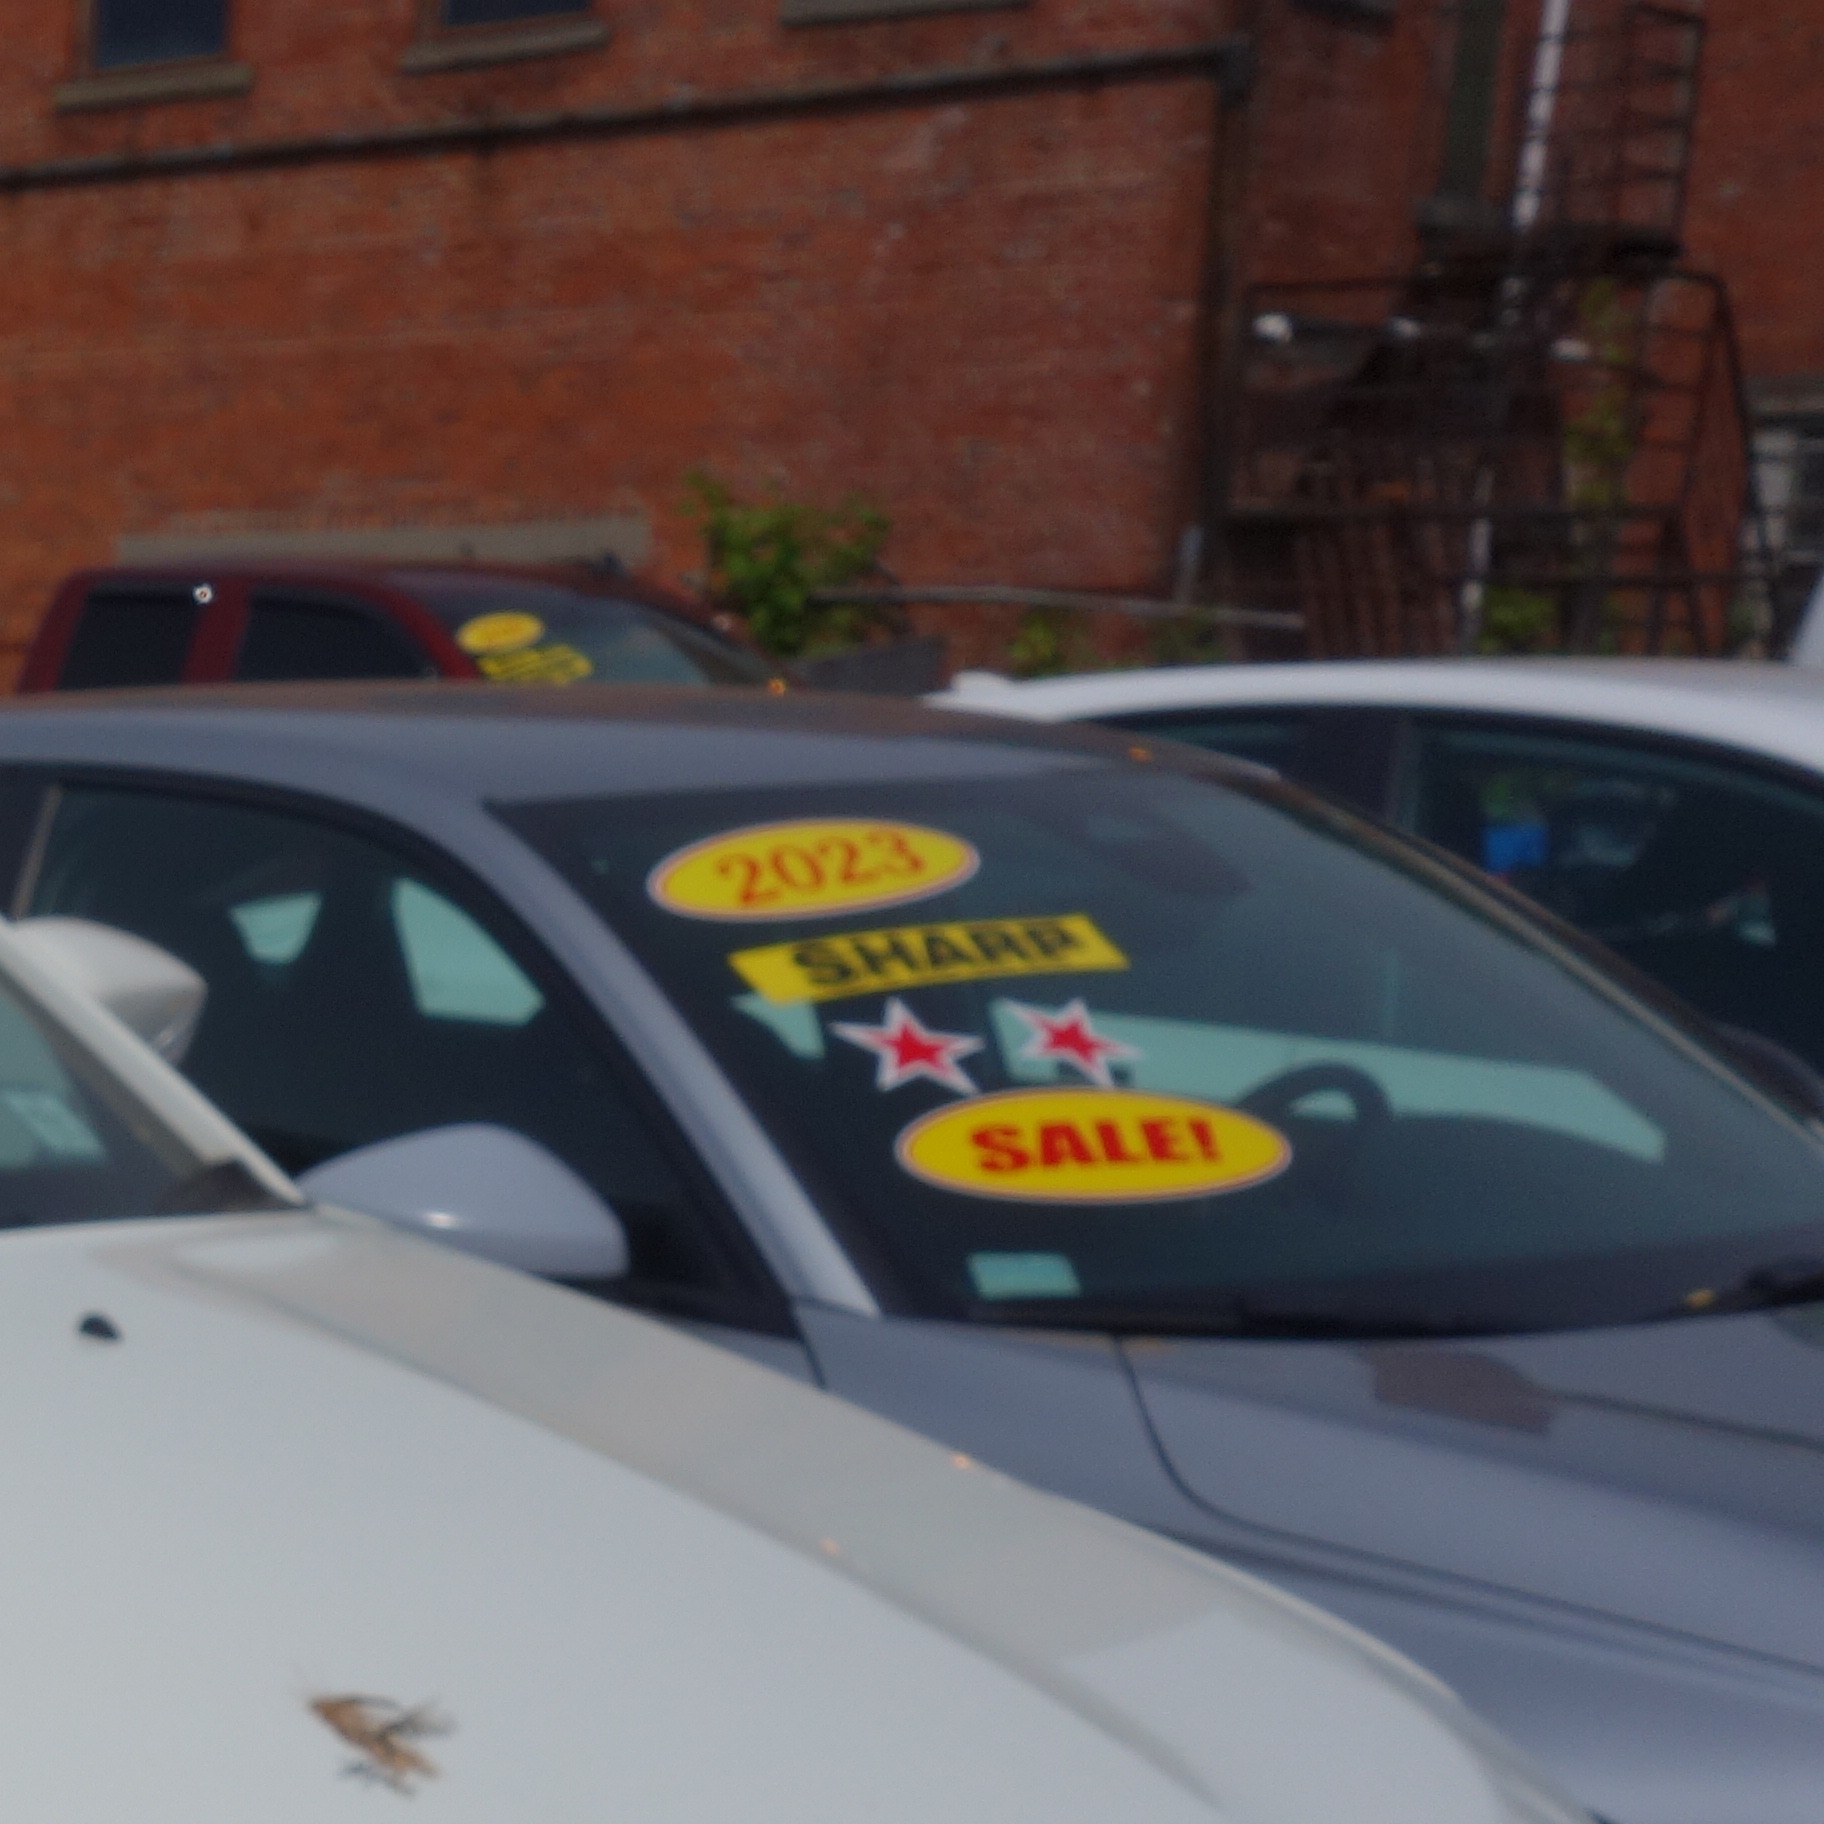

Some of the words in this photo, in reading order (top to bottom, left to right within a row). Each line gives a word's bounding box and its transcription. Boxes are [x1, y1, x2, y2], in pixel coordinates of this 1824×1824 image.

[718, 829, 925, 907] 2023
[793, 921, 1089, 986] SHARP
[970, 1118, 1220, 1175] SALE!
